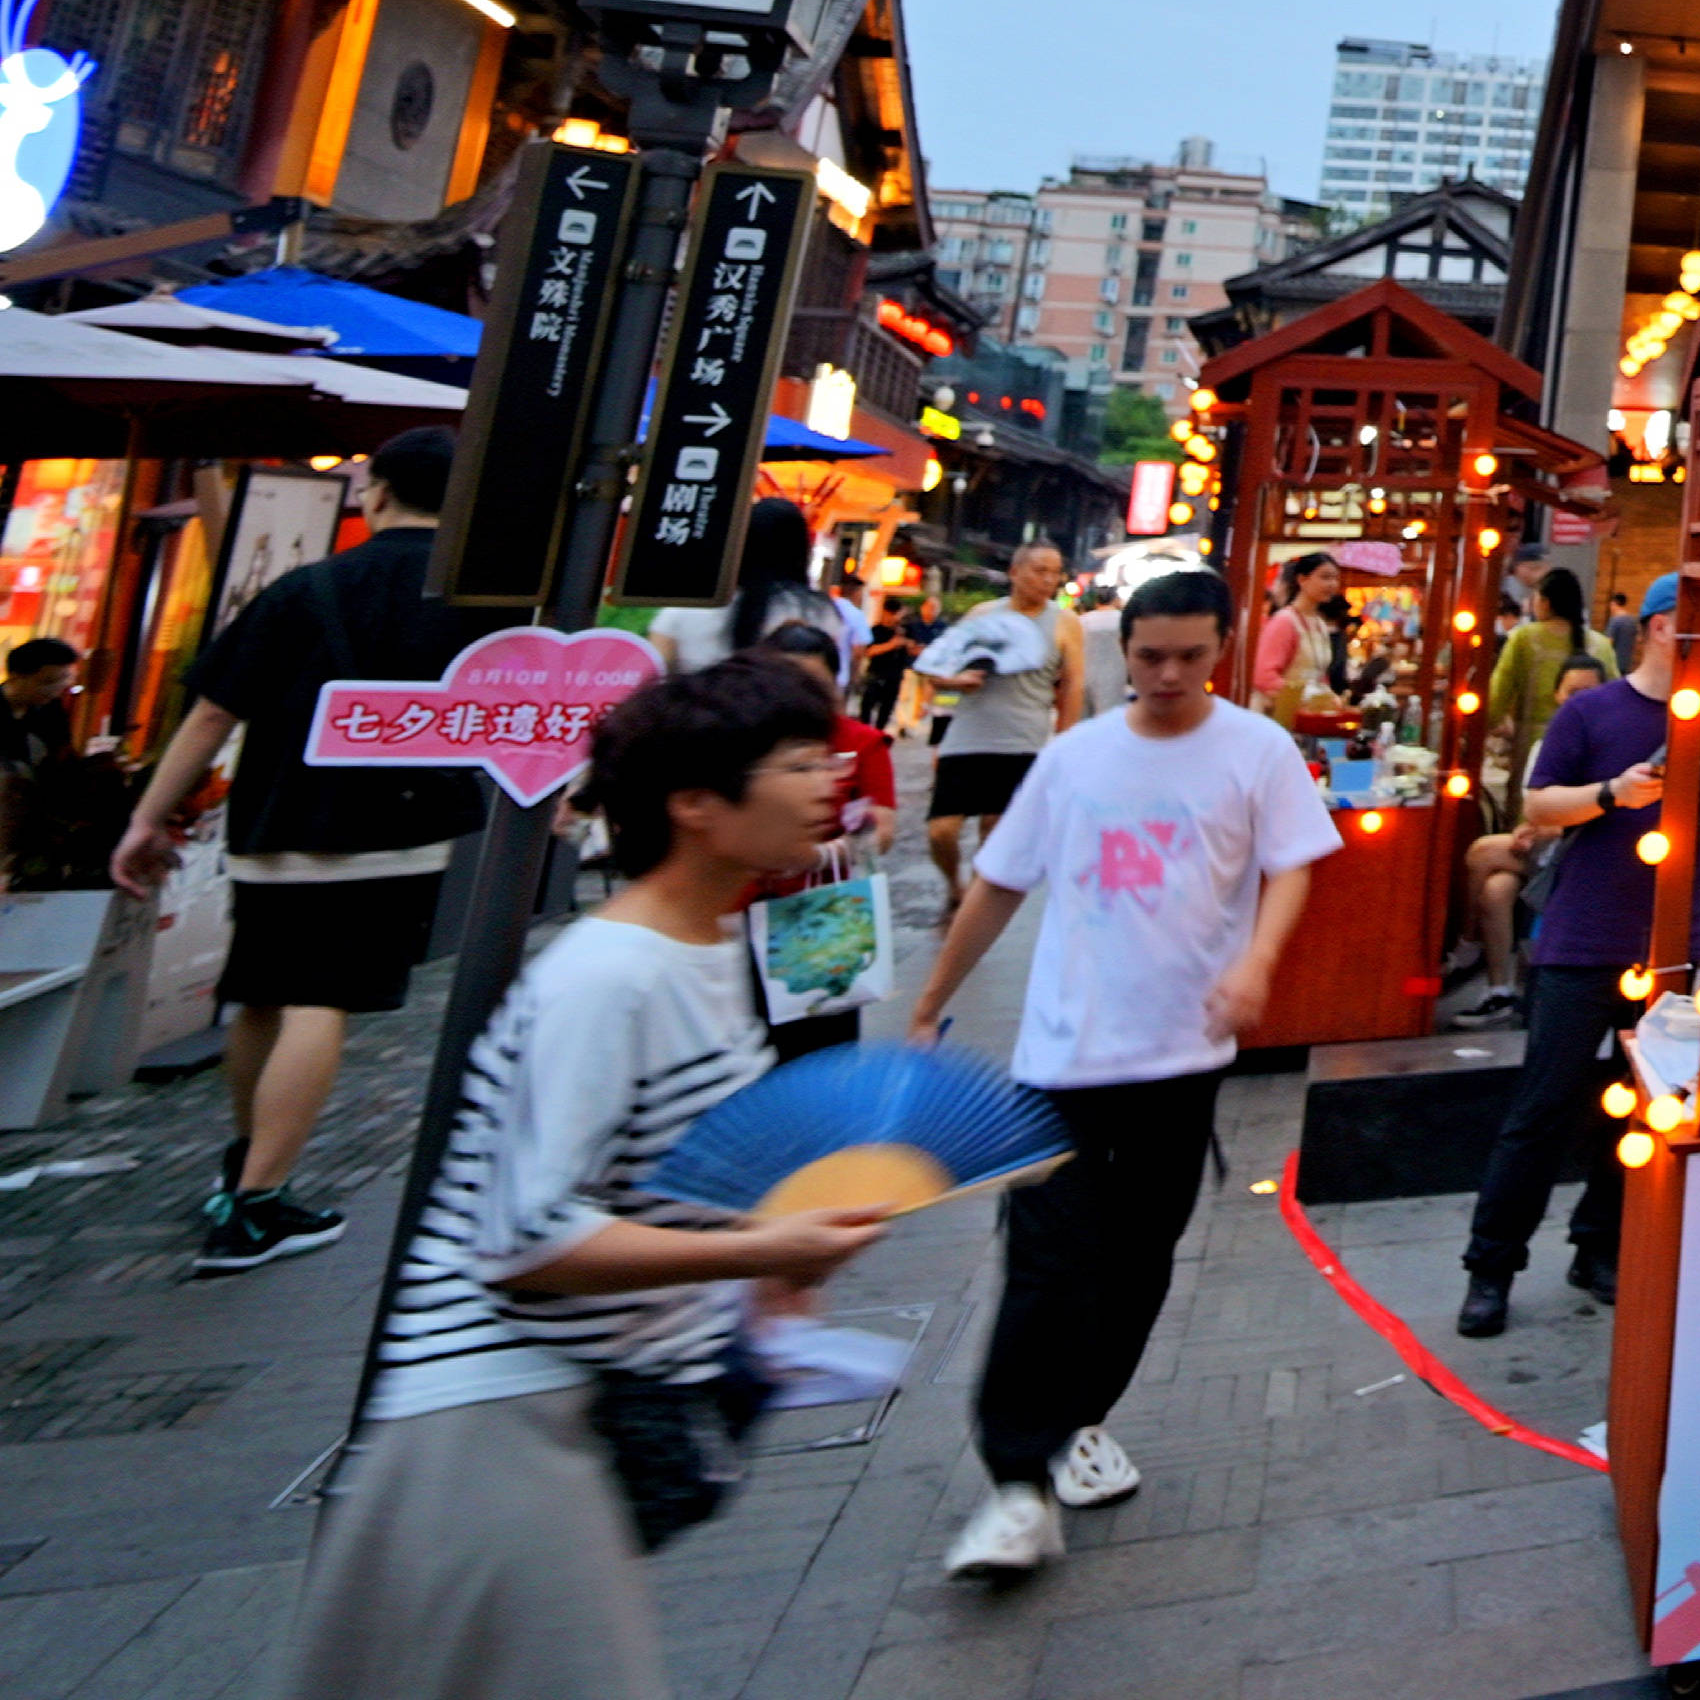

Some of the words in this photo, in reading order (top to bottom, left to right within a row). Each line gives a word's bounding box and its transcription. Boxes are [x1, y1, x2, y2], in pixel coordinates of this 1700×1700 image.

[529, 246, 577, 342] 文殊院
[690, 262, 745, 387] 汉秀广场
[655, 483, 699, 546] 剧场
[334, 703, 612, 745] 七夕非遗好
